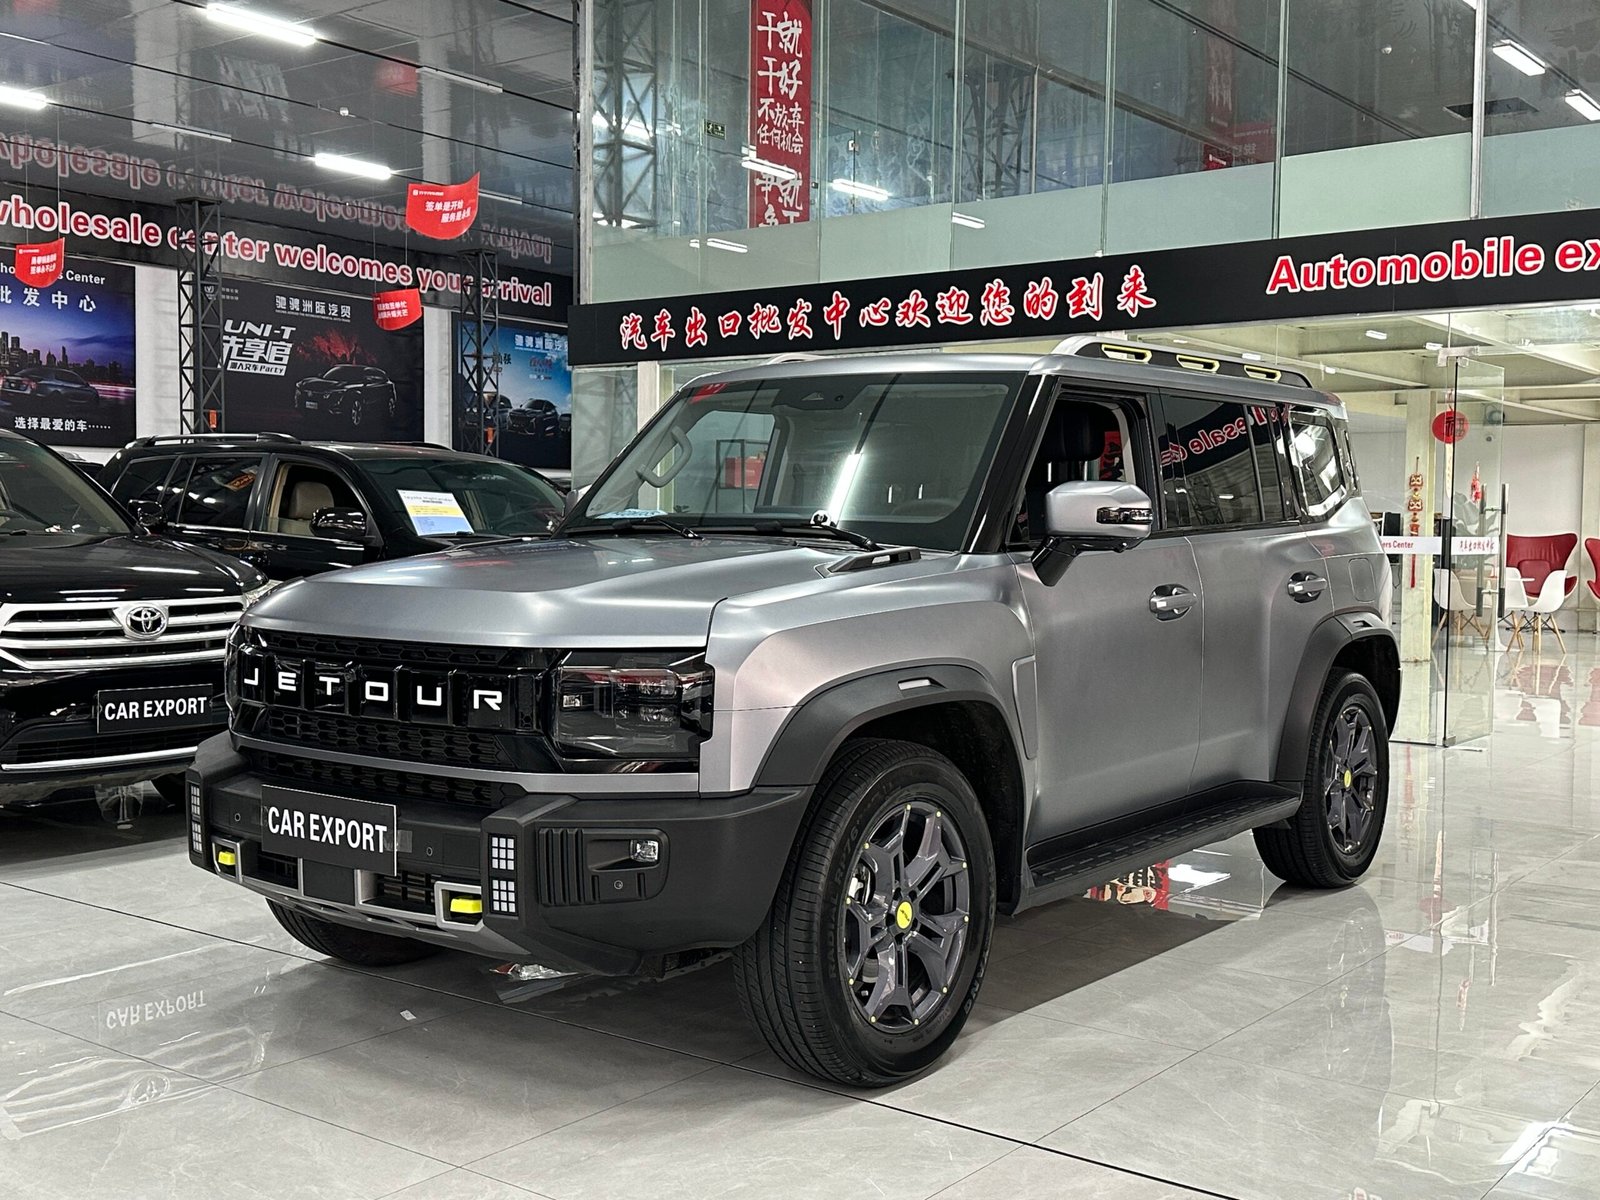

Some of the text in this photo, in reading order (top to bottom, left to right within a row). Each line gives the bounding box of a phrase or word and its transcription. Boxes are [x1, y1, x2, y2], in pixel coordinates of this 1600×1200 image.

[757, 11, 803, 58] 干就
[757, 56, 803, 101] 干好
[757, 97, 804, 135] 不放弃
[757, 122, 804, 156] 任何机会
[66, 270, 106, 285] Center
[273, 242, 413, 286] welcomes
[416, 266, 474, 295] your
[1266, 236, 1545, 295] Automobile
[620, 264, 1157, 352] 汽车出口批发中心欢迎您的到来
[224, 319, 296, 340] UNI-T
[260, 364, 284, 374] Party
[1393, 540, 1414, 549] Center
[104, 696, 207, 721] CAR EXPORT
[243, 667, 503, 711] JETOUR
[267, 806, 388, 854] CAR EXPORT
